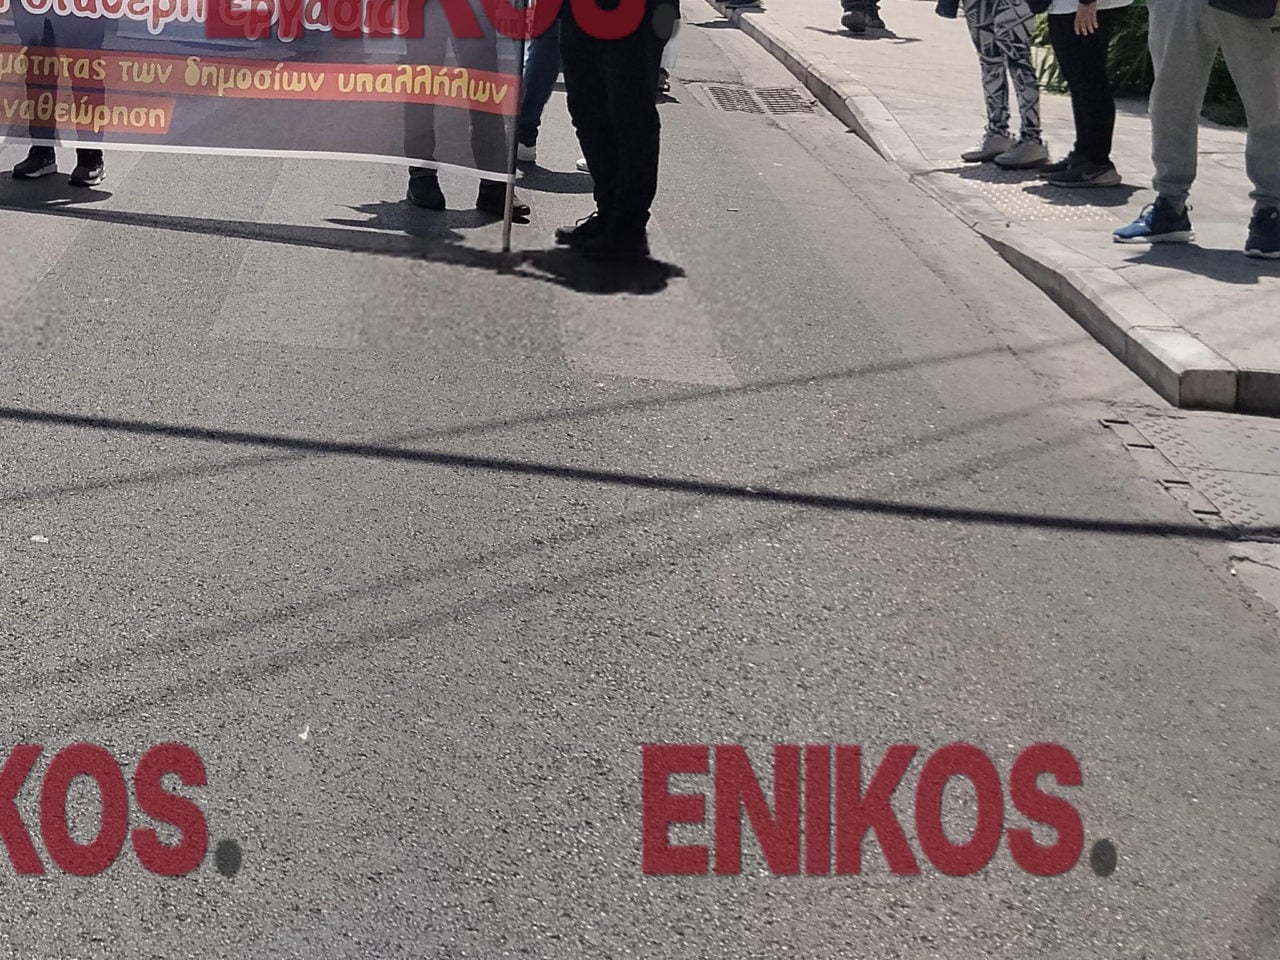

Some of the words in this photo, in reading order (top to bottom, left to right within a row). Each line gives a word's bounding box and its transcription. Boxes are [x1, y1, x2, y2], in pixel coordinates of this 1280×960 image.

[118, 59, 173, 85] των
[184, 56, 325, 97] δημοσίων
[337, 64, 509, 106] υπαλλήλων
